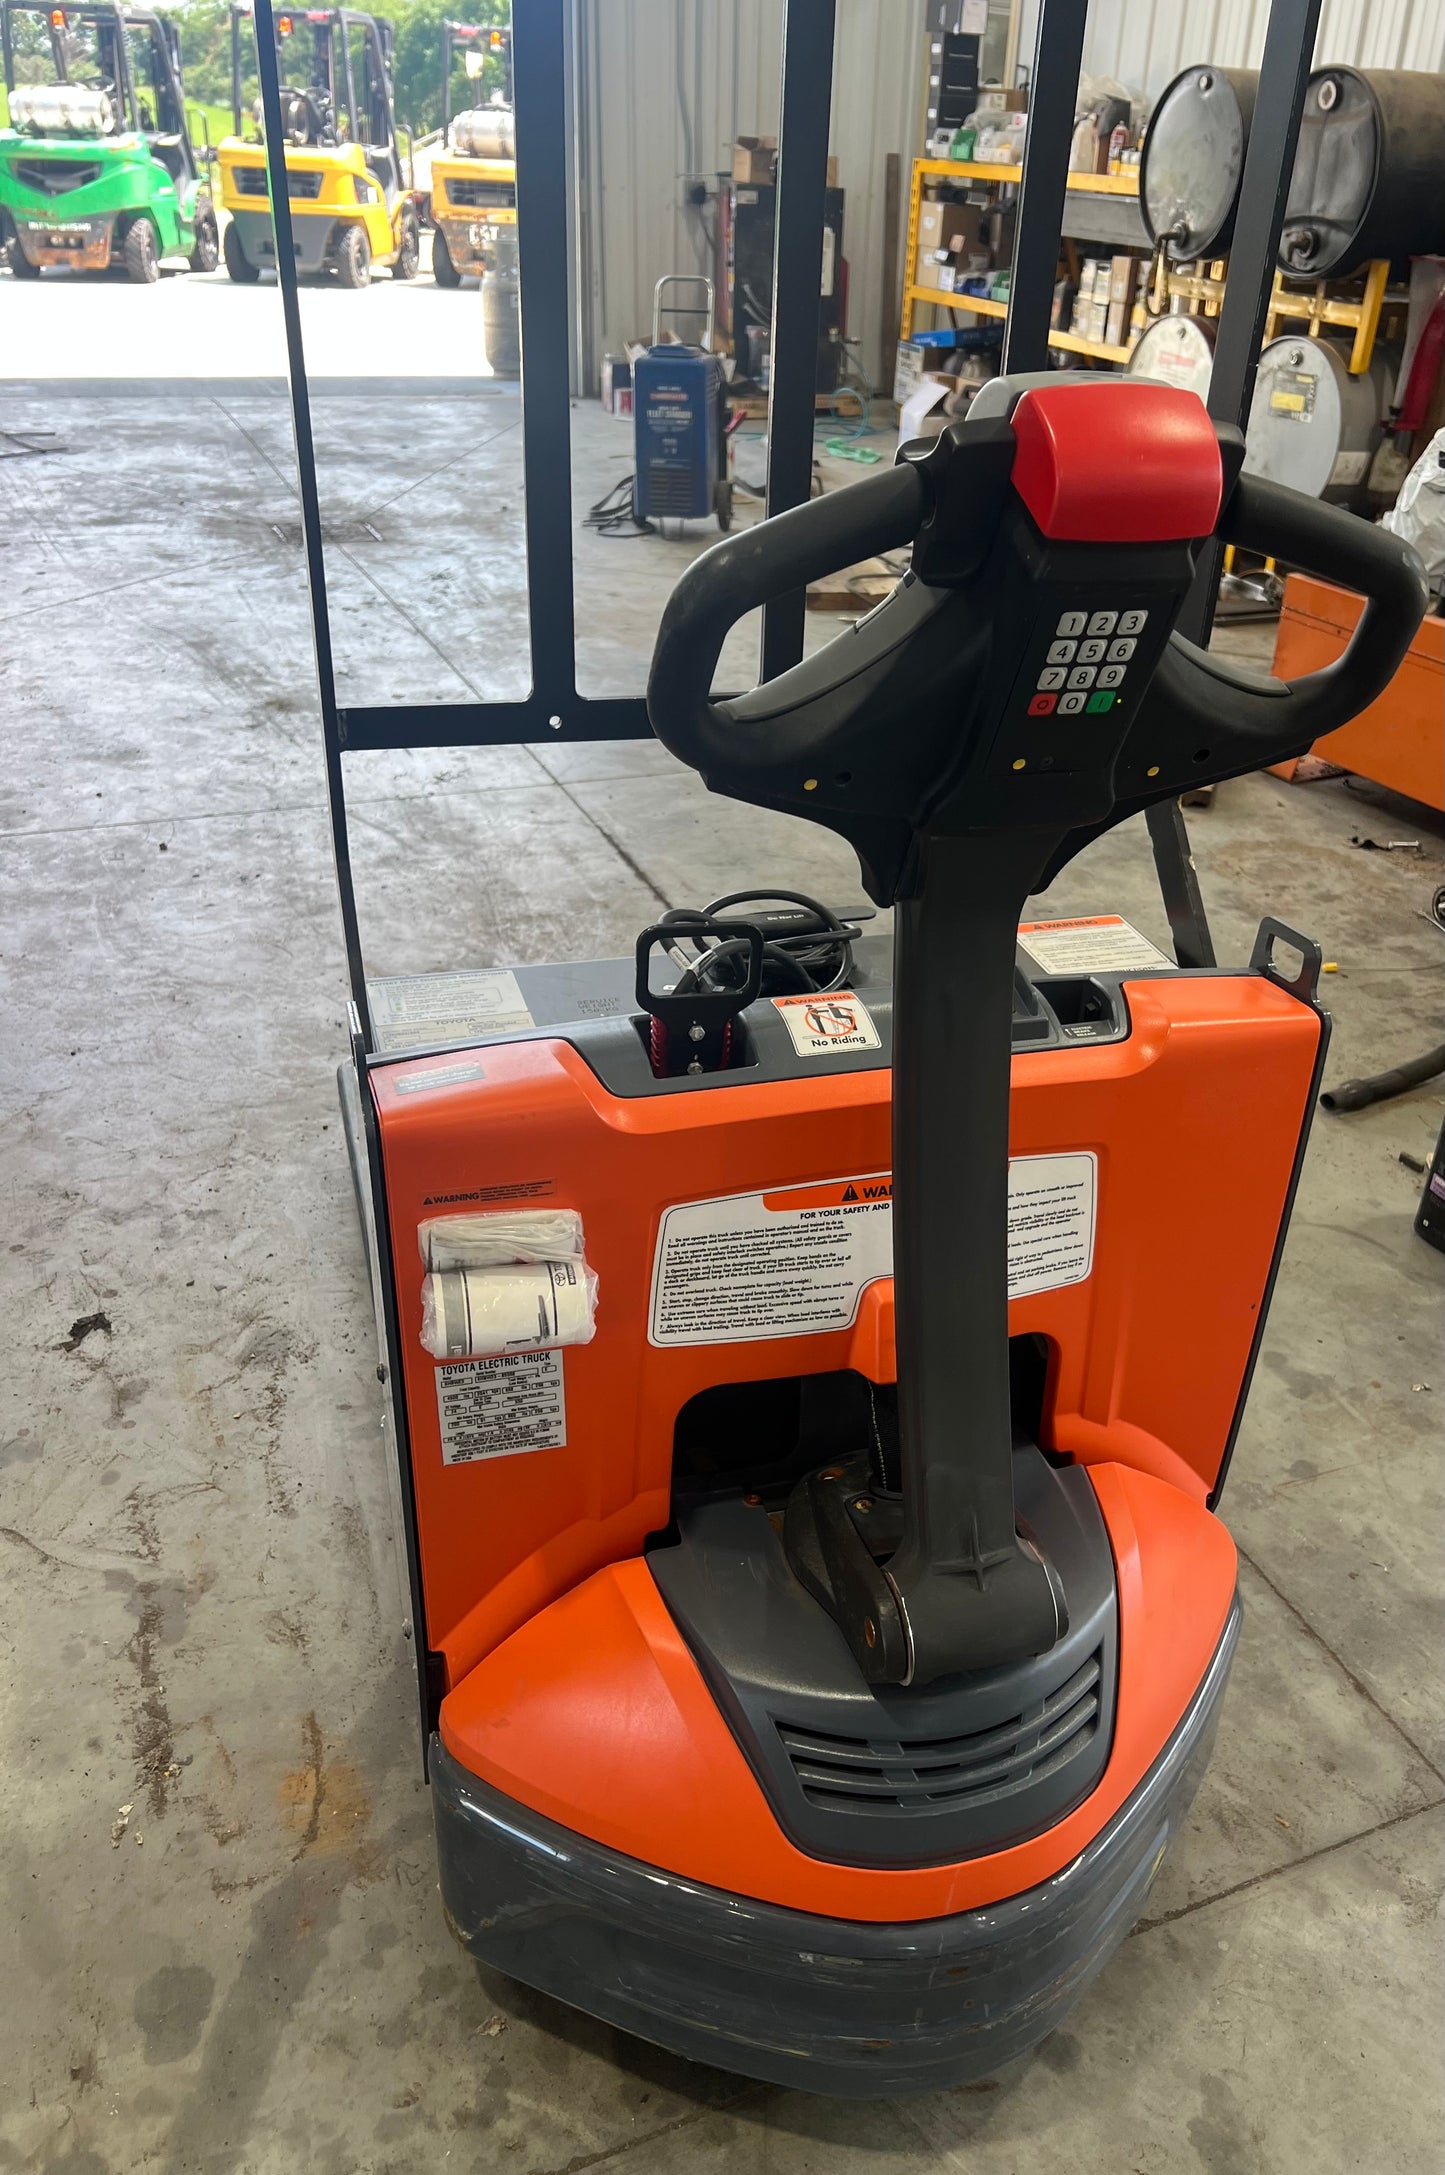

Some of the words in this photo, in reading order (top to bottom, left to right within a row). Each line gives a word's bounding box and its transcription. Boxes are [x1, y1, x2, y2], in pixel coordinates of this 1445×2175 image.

[1069, 618, 1076, 632] 1
[1096, 617, 1109, 631] 2
[1126, 616, 1138, 630] 3
[1057, 645, 1068, 659] 4
[1086, 645, 1099, 658] 5
[1117, 644, 1127, 657] 6
[1047, 673, 1059, 686] 7
[1076, 672, 1088, 685] 8
[1107, 671, 1118, 684] 9
[1066, 697, 1078, 710] 0
[1045, 920, 1098, 930] WARNING
[796, 995, 852, 1005] WARNING
[435, 1018, 477, 1026] TOYOTA
[832, 1036, 867, 1045] Riding
[433, 1193, 479, 1204] WARNING
[819, 1210, 841, 1218] YOUR
[843, 1206, 870, 1215] SAFETY
[872, 1203, 890, 1211] AND
[441, 1363, 476, 1376] TOYOTA
[479, 1357, 519, 1371] ELECTRIC
[522, 1352, 551, 1363] TRUCK
